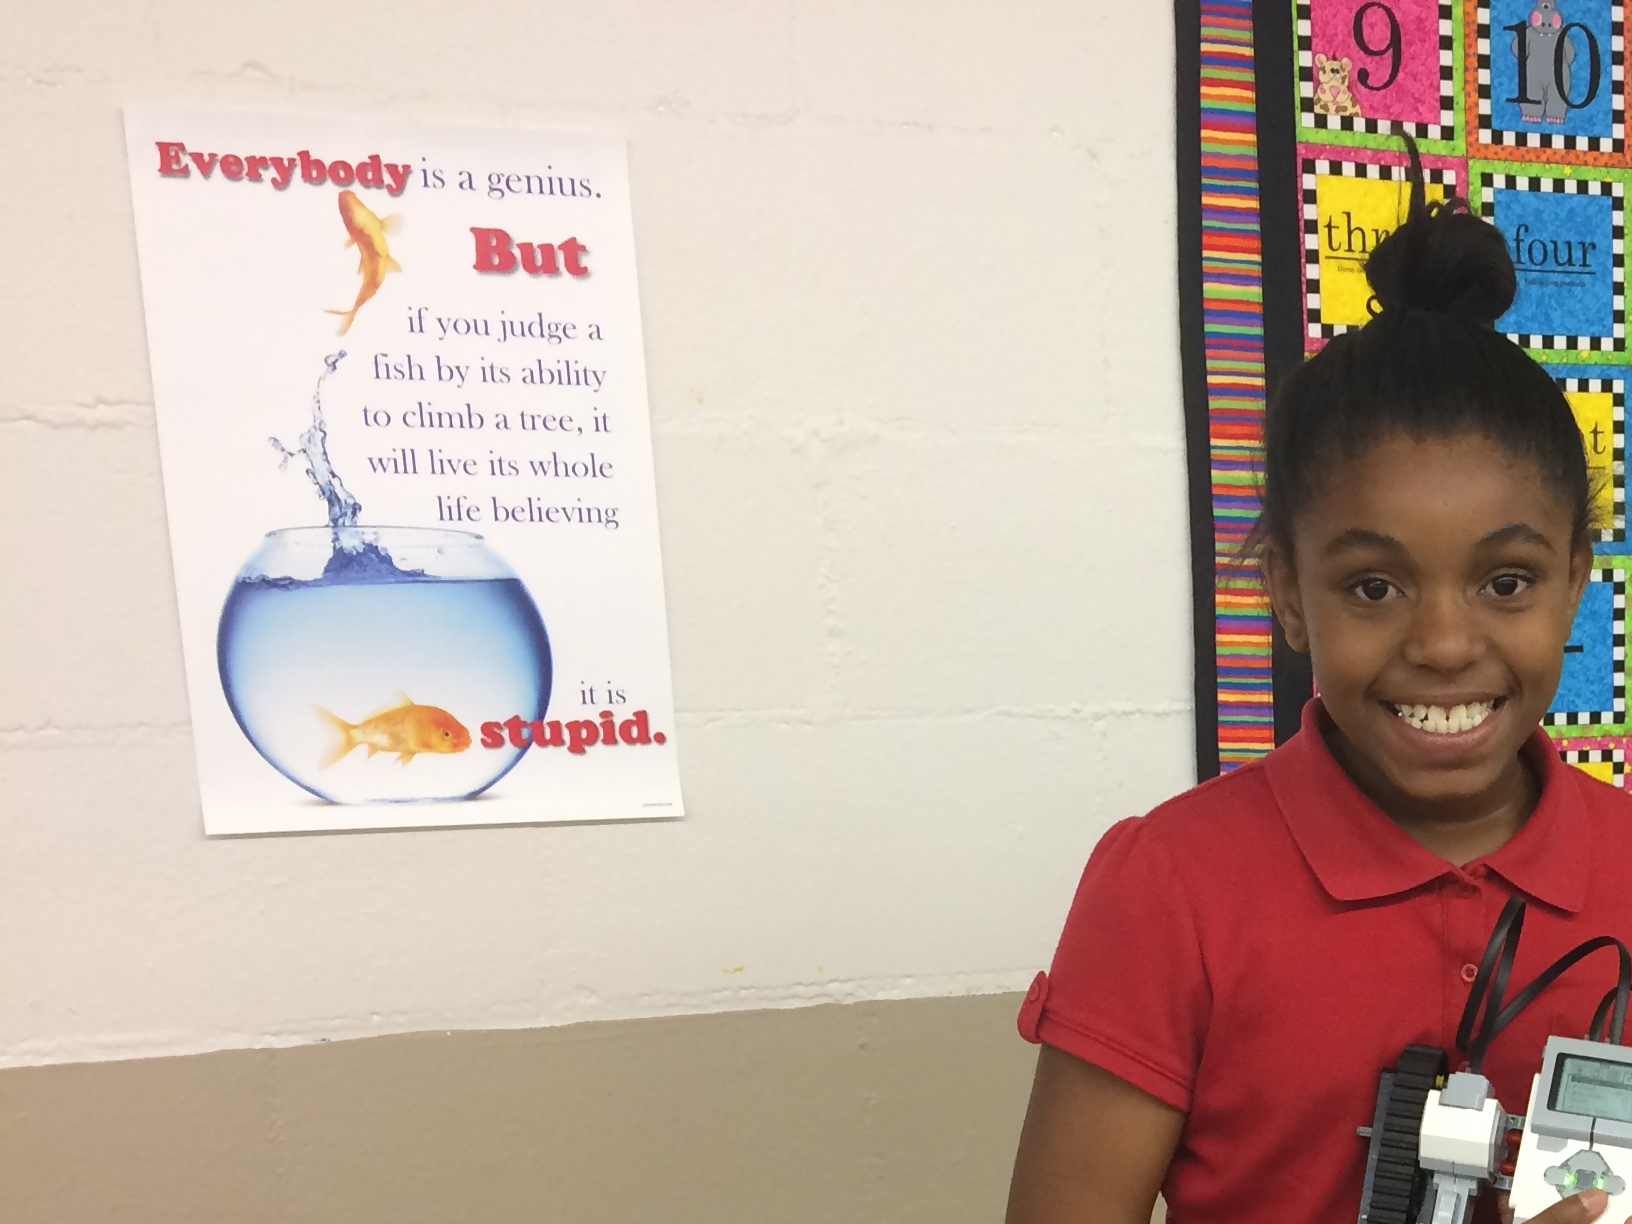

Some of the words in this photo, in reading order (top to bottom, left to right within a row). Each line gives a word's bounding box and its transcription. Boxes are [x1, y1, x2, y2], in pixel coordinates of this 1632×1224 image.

[1353, 2, 1402, 91] 9
[1503, 20, 1600, 109] 10
[156, 141, 411, 198] Everybody
[420, 156, 446, 189] is
[458, 170, 477, 192] a
[487, 164, 602, 199] genius.
[469, 226, 588, 278] But
[1323, 211, 1391, 254] thr
[1513, 224, 1597, 268] four
[407, 305, 429, 334] if
[436, 317, 491, 341] you
[496, 310, 577, 345] judge
[588, 323, 604, 341] a
[373, 352, 426, 381] fish
[434, 354, 470, 389] by
[480, 356, 511, 384] its
[521, 358, 607, 393] ability
[362, 405, 392, 427] to
[402, 402, 485, 430] climb
[494, 413, 511, 431] a
[519, 410, 583, 436] tree,
[593, 406, 611, 433] it
[367, 447, 419, 475] will
[427, 448, 478, 476] live
[488, 449, 520, 477] its
[528, 451, 613, 479] whole
[436, 495, 481, 522] life
[491, 496, 620, 530] believing
[580, 680, 596, 706] it
[606, 680, 627, 705] is
[480, 709, 666, 754] stupid.
